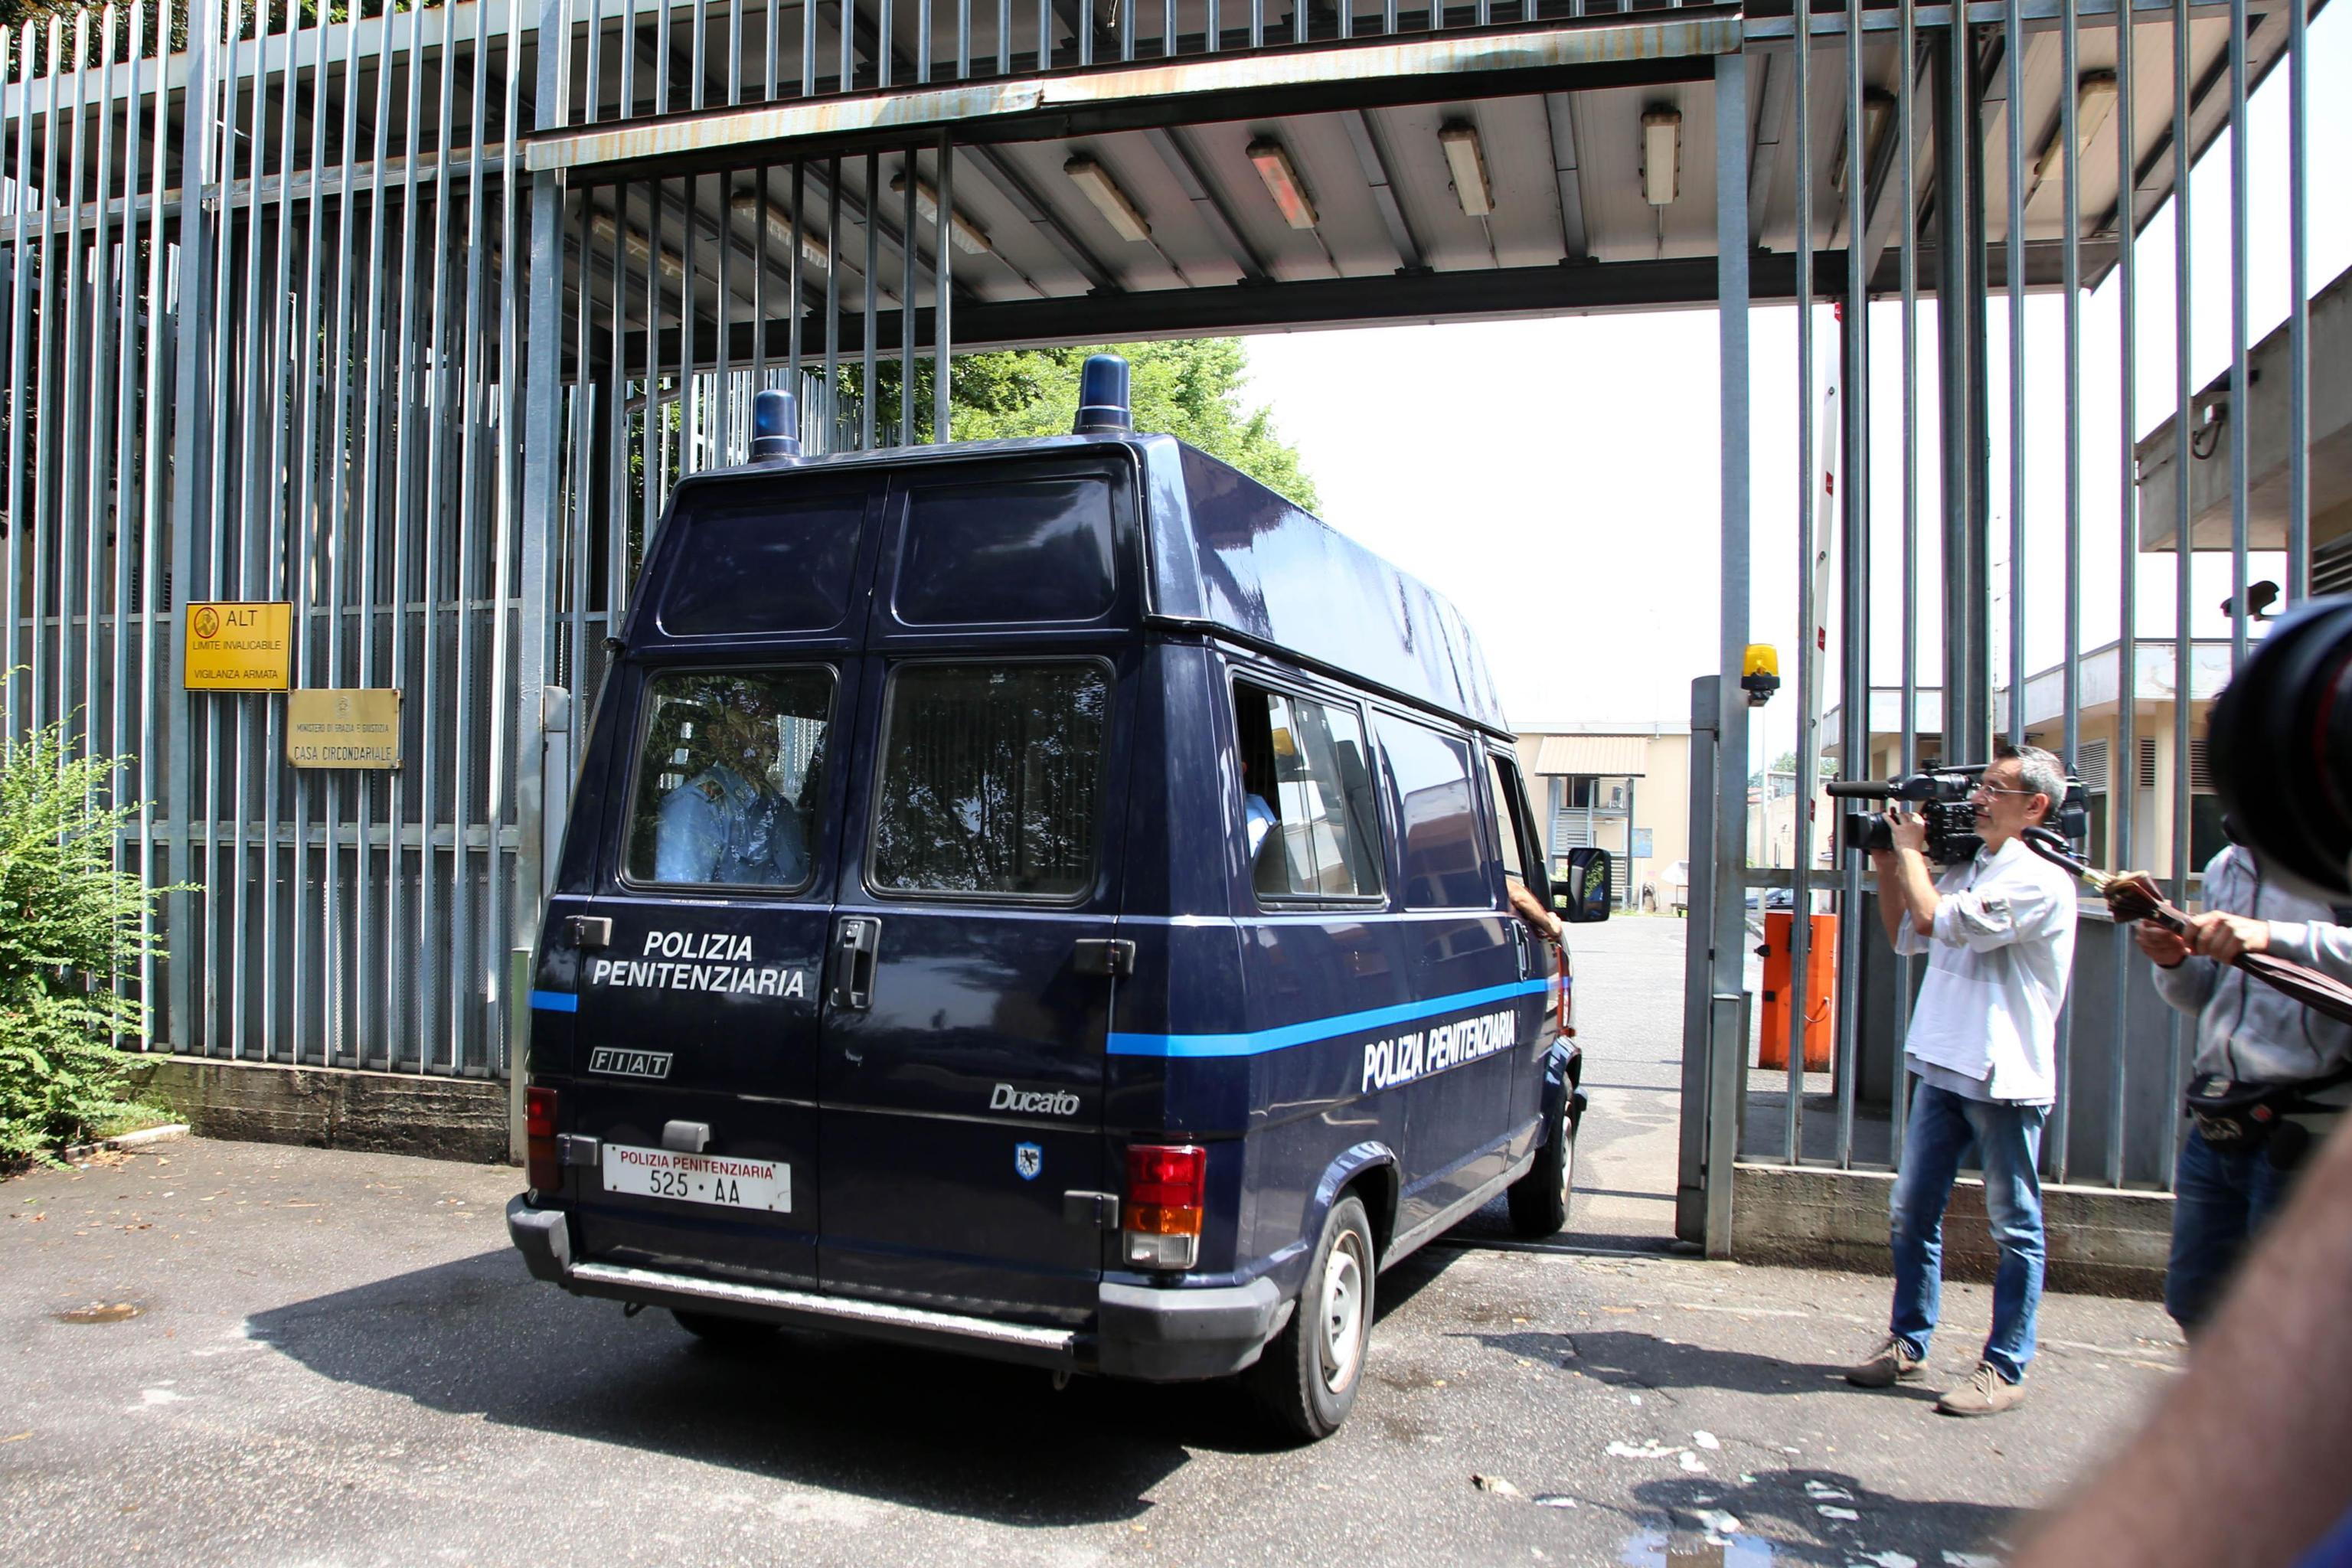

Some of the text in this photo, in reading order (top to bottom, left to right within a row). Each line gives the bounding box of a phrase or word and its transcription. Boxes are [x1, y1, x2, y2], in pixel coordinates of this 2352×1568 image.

[226, 610, 258, 626] ALT
[192, 640, 282, 650] LIMITE INVALICABILE
[194, 669, 278, 679] VIGILANZA ARMATA
[294, 746, 392, 761] CASA CIRCONDARIALE
[643, 931, 753, 962] POLIZIA
[592, 960, 804, 998] PENITENZIARIA
[593, 1050, 668, 1076] FIAT
[1361, 1008, 1515, 1094] POLIZIA PENITENZIARIA
[989, 1083, 1080, 1116] Ducato
[621, 1151, 773, 1180] POLIZIA PENITENZIARIA
[650, 1170, 740, 1205] 525 AA
